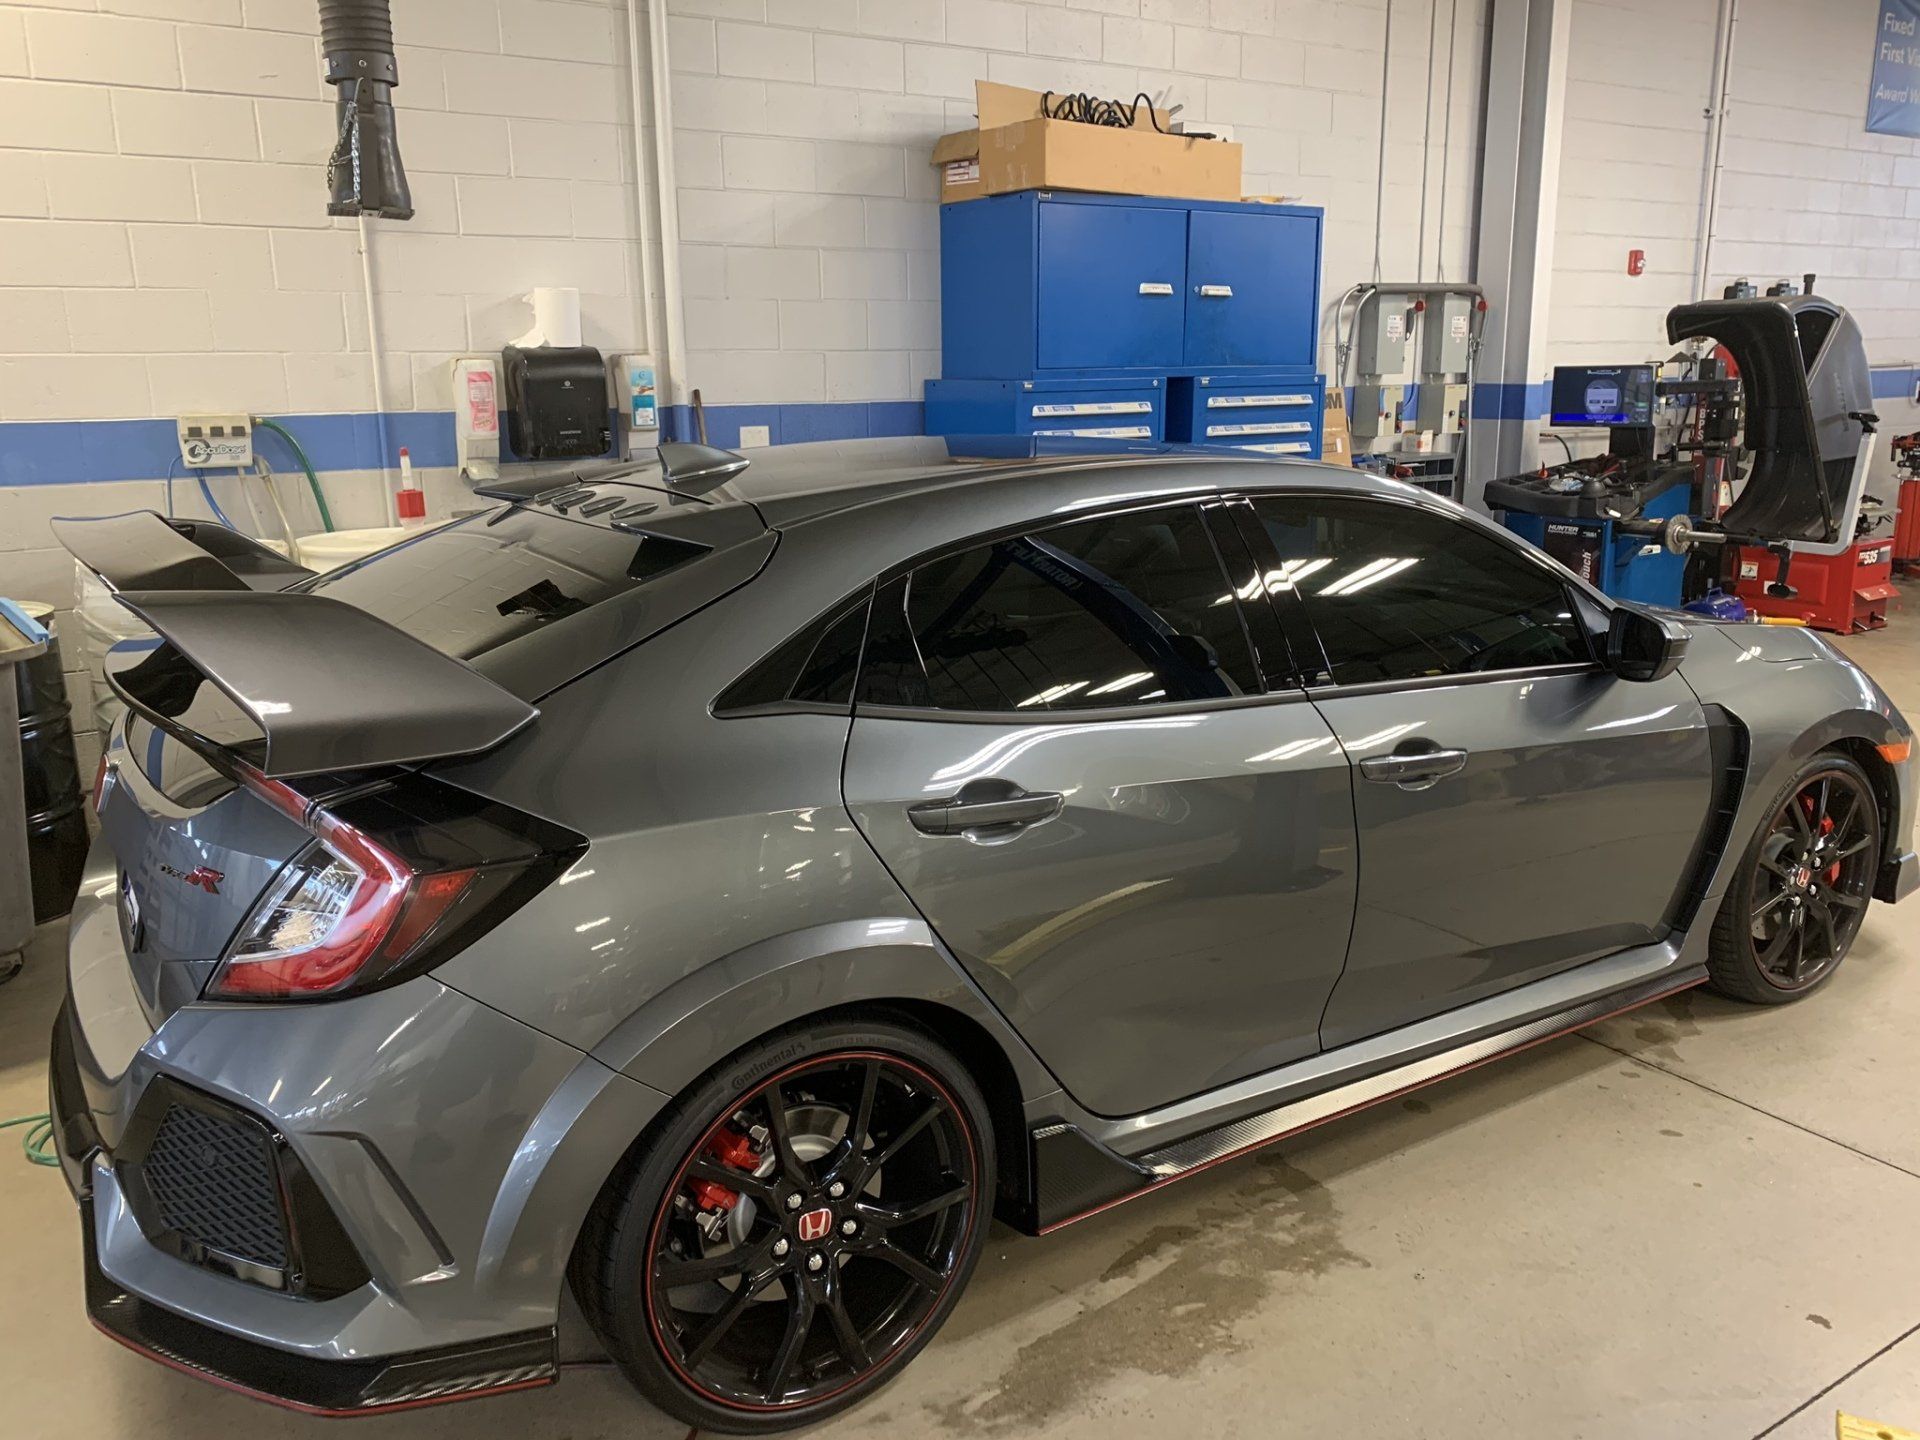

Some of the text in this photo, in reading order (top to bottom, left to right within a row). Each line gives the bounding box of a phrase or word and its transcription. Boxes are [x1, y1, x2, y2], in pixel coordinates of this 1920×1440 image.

[1884, 12, 1916, 36] Fixed
[1881, 42, 1904, 64] First
[1875, 84, 1908, 103] Award
[194, 444, 246, 455] AccuDose
[1548, 524, 1579, 533] HUNTER
[731, 1046, 799, 1090] Continental
